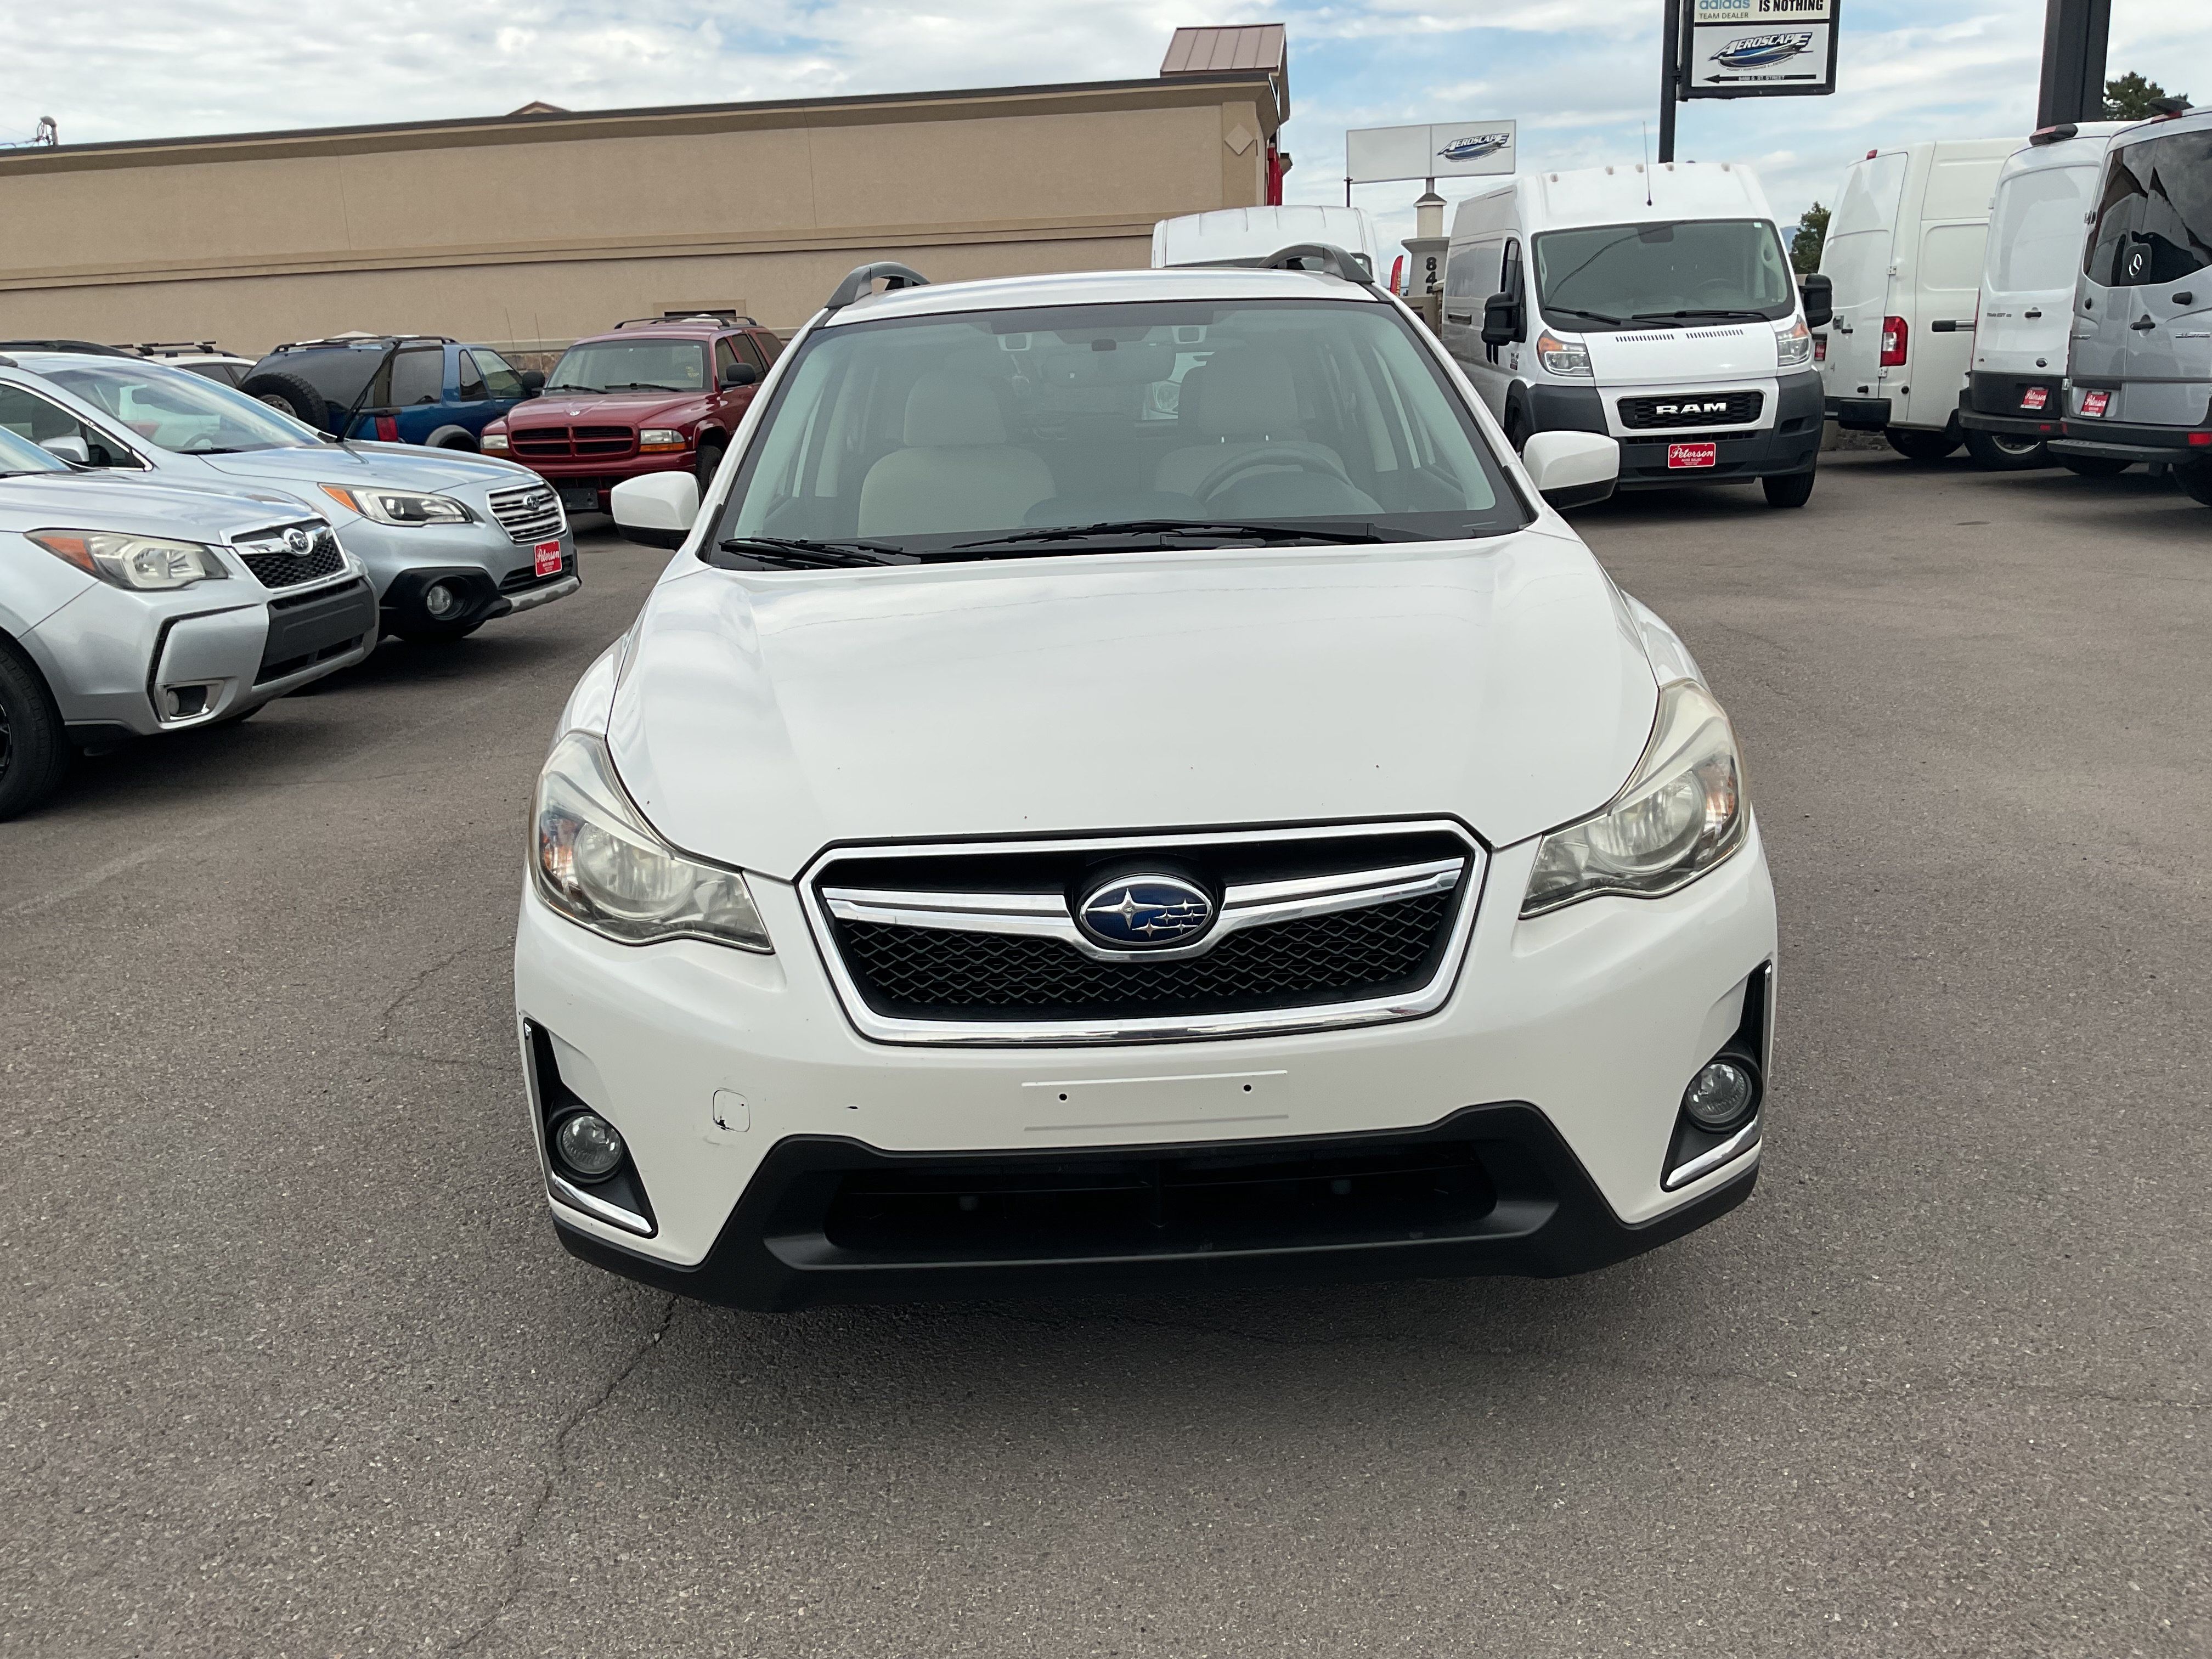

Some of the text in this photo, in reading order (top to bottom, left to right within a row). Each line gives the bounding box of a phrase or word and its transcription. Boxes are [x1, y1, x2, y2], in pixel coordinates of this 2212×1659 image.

[1759, 0, 1824, 12] IS NOTHING
[1711, 32, 1813, 59] AEROSCAPE
[1438, 133, 1510, 155] AEROSCAPE
[1656, 402, 1726, 415] RAM
[1670, 447, 1714, 459] Peterson
